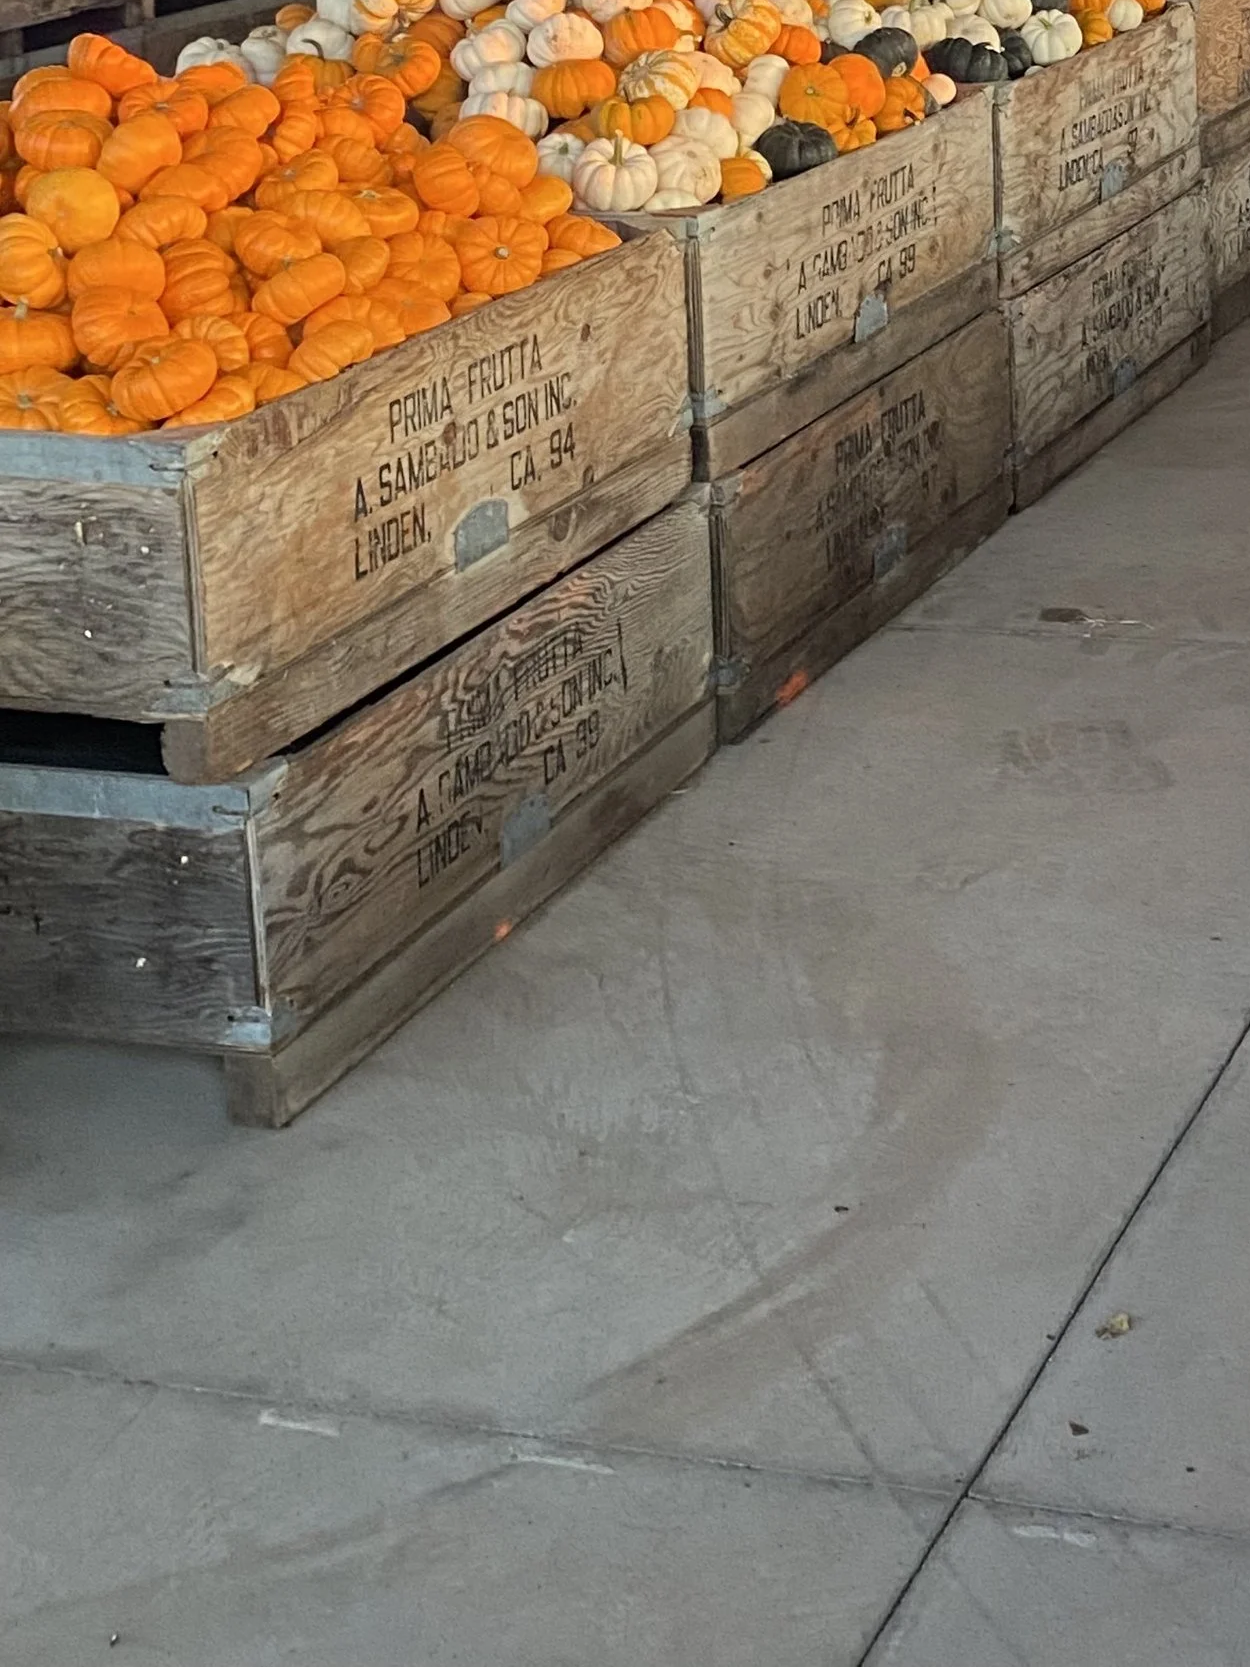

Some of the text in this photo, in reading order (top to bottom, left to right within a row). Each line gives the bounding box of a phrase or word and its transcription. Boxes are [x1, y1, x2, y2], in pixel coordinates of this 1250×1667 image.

[388, 333, 543, 444] PRIMA FRUTTA
[354, 371, 578, 523] A. SAMBADO & SON INC.
[510, 421, 576, 491] CA. 94
[354, 502, 432, 581] LINDEN,
